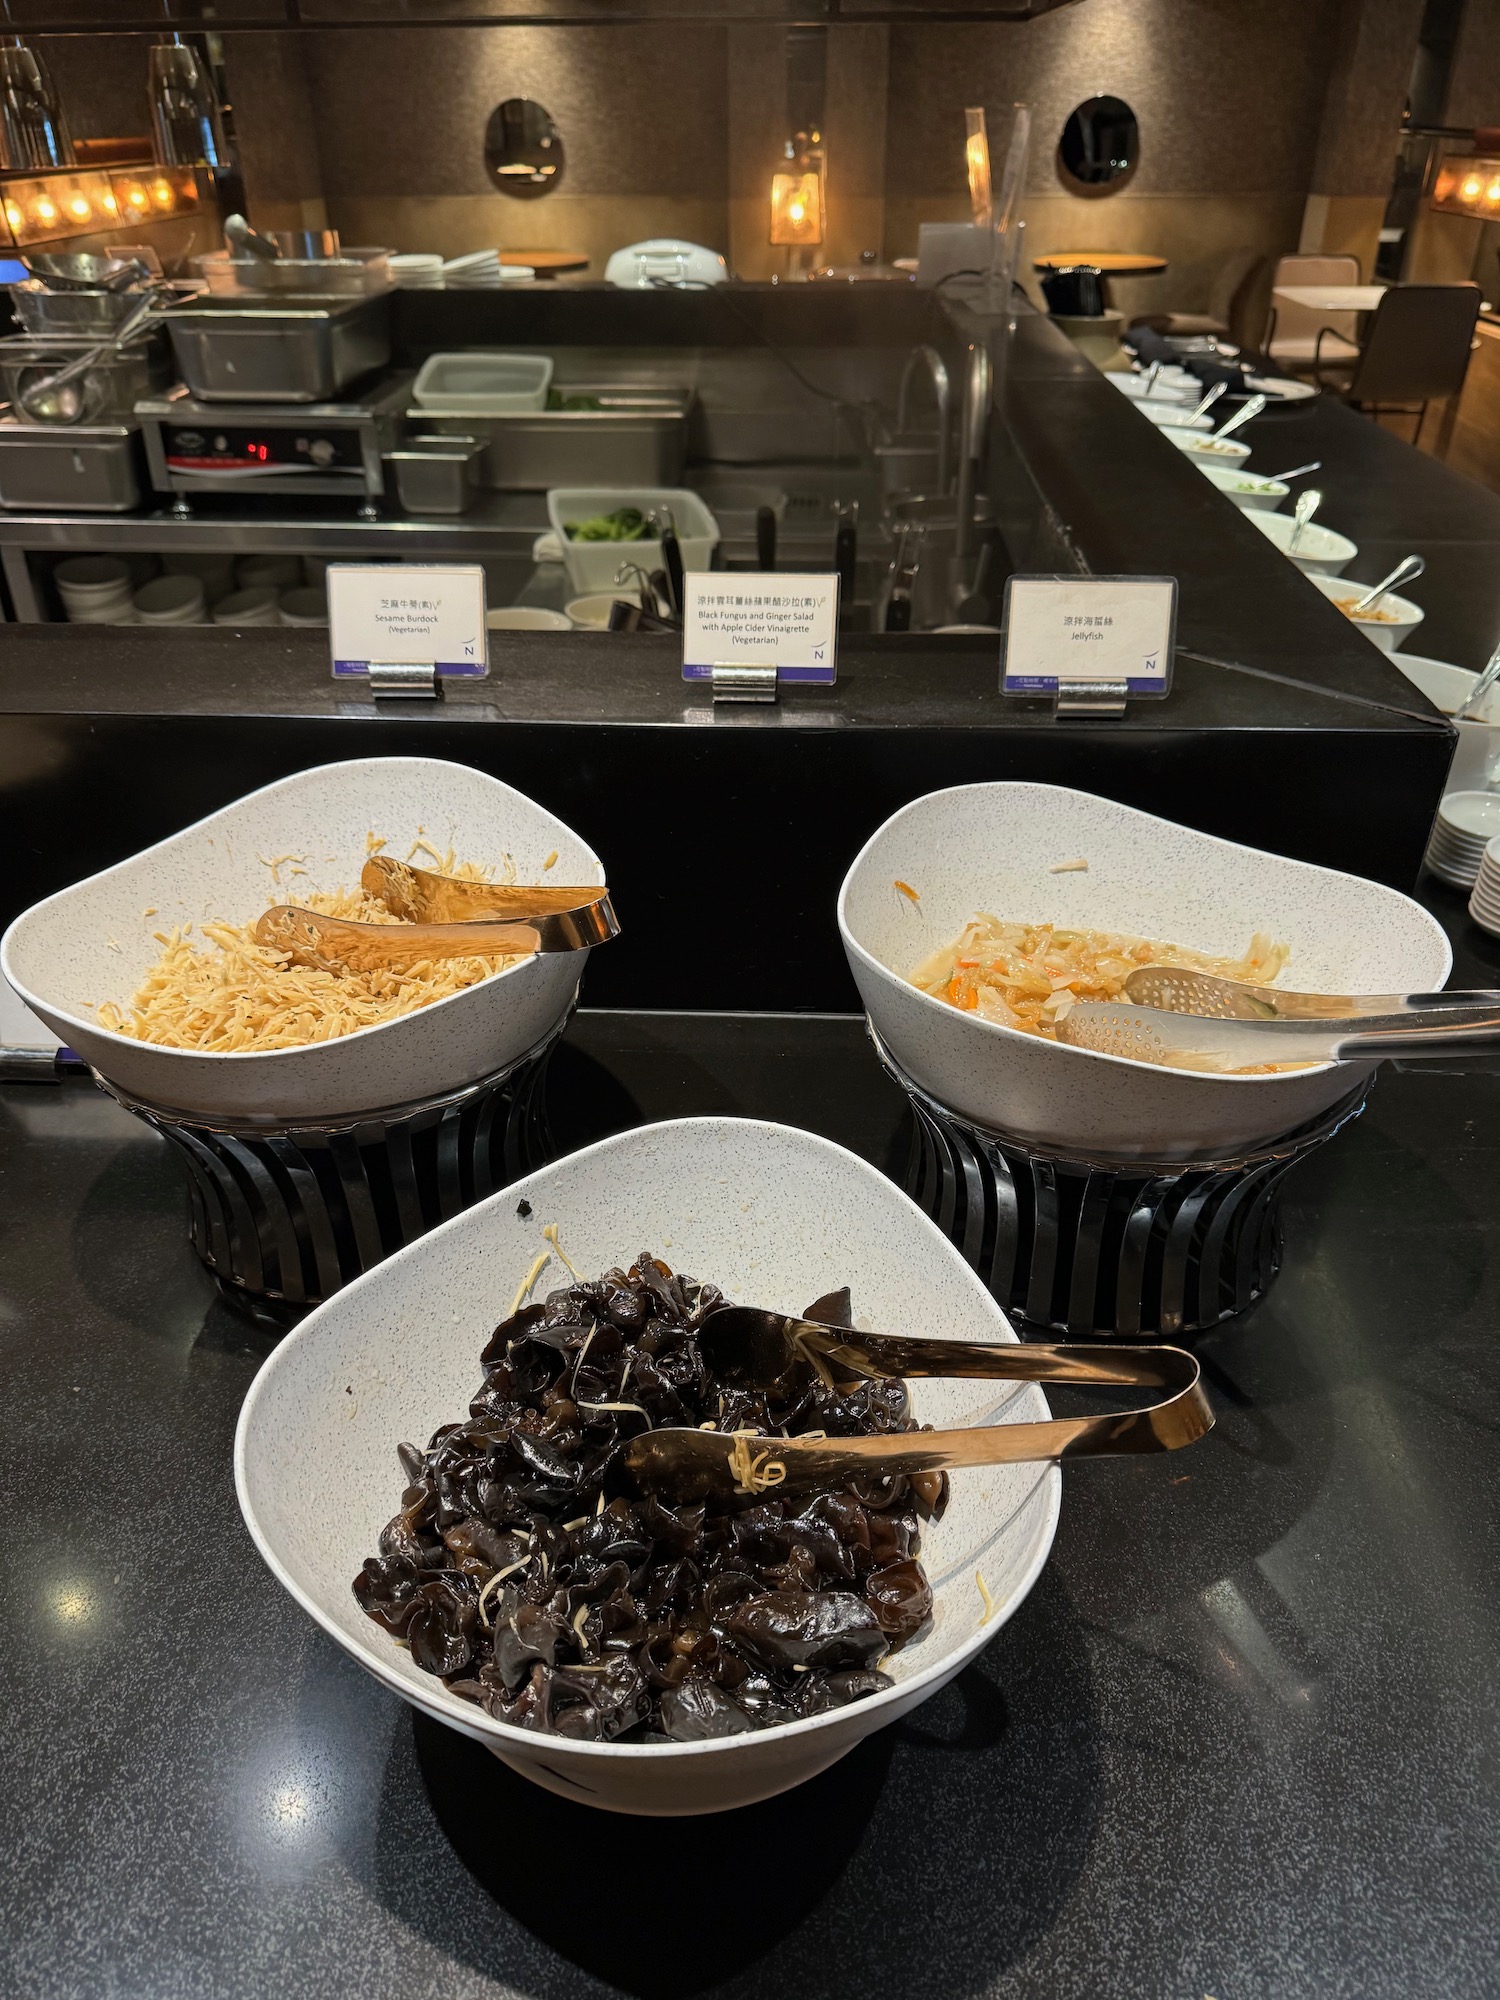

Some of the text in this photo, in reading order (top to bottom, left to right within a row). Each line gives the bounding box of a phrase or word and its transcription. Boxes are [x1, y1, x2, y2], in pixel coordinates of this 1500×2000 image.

[375, 614, 439, 623] Sesame Burdock
[698, 611, 814, 622] Black Fungus and Ginger Salad
[388, 626, 431, 634] (Vegetarian)
[702, 623, 809, 634] with Apple Cider Vinaigrette
[732, 636, 779, 646] (Vegetarian)
[1071, 631, 1103, 641] Jellyfish
